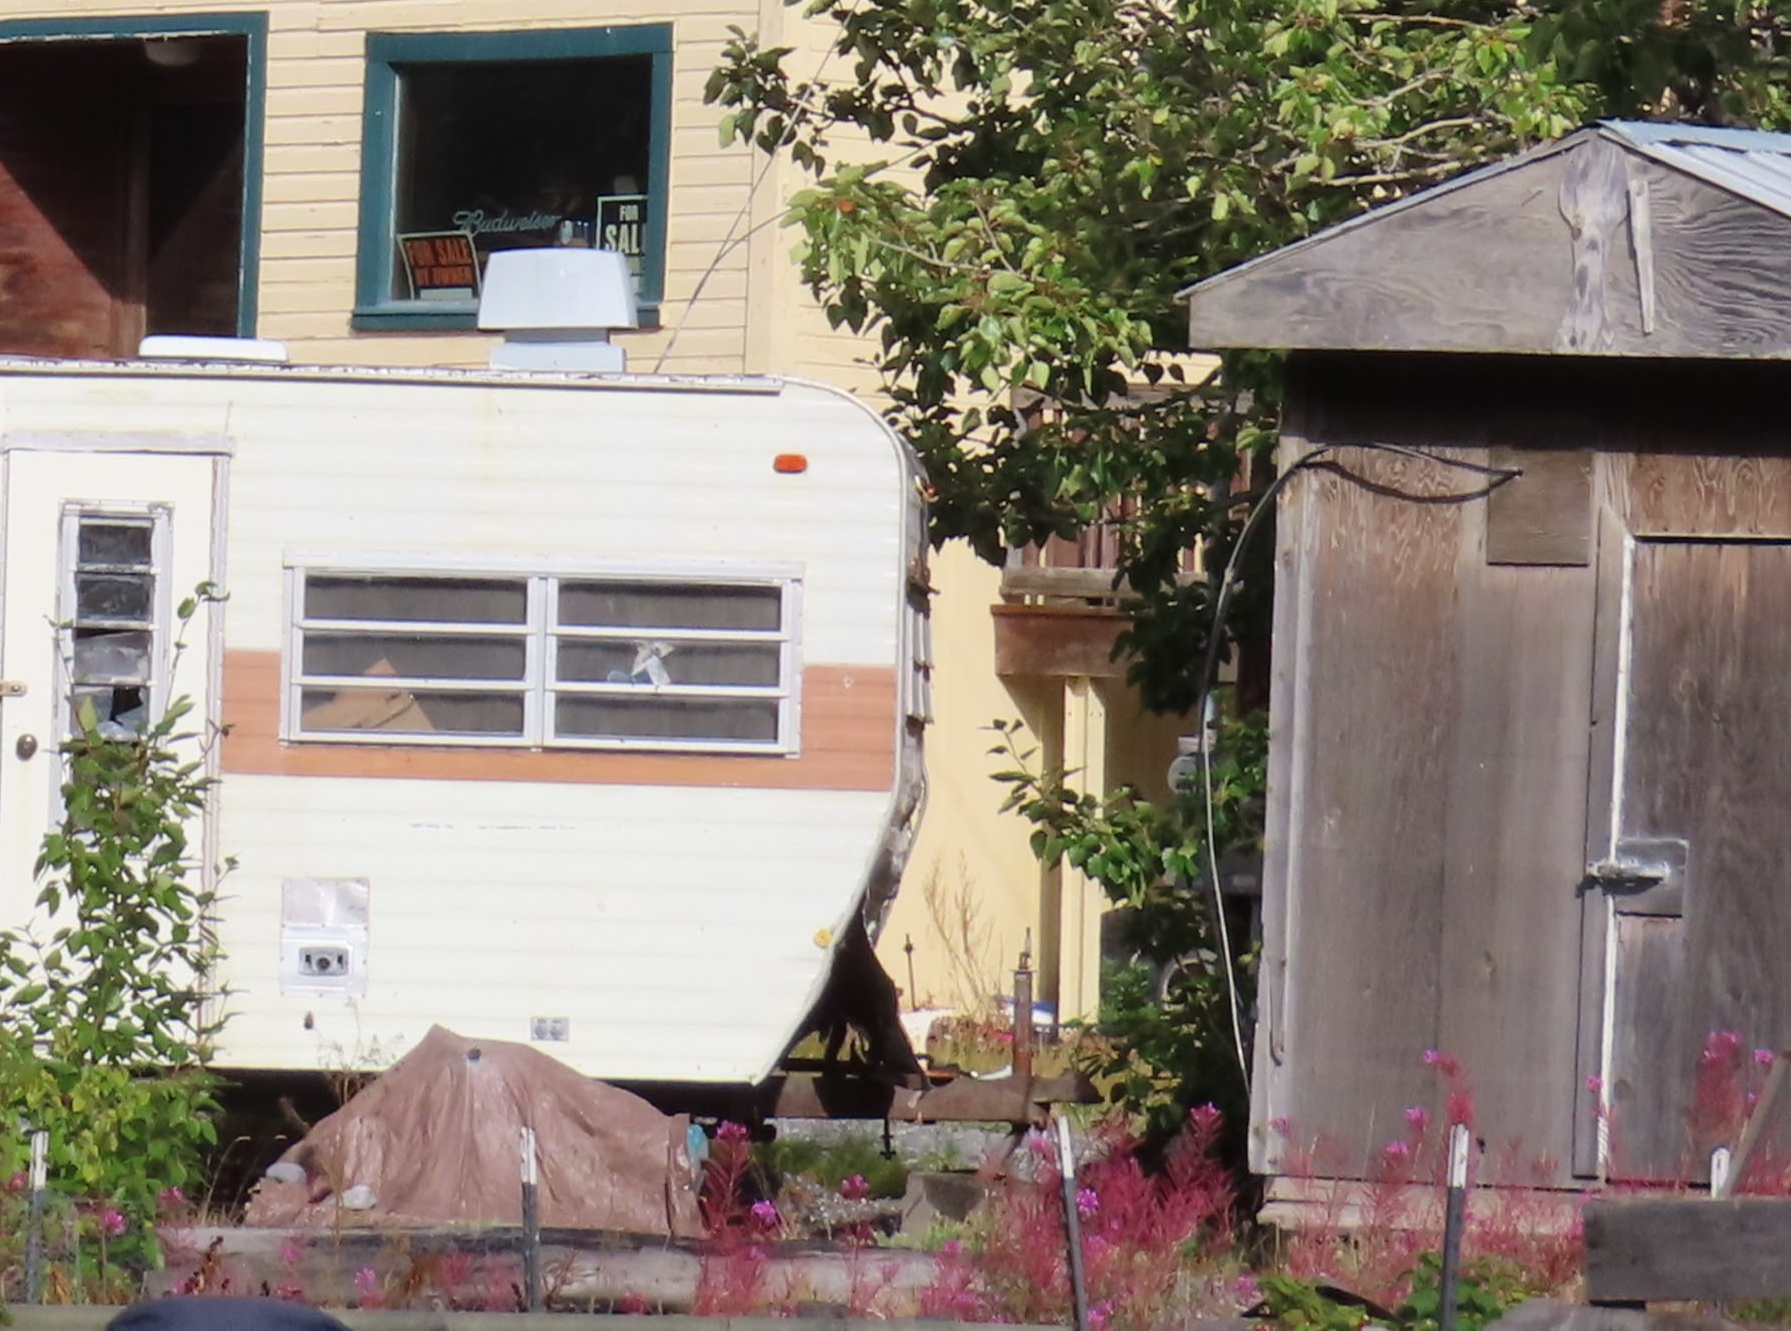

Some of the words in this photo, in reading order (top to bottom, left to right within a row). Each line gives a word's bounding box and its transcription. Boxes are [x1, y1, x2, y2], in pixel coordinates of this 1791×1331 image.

[453, 209, 561, 236] Budweiser
[620, 205, 639, 221] FOR
[435, 238, 472, 264] SALE
[605, 223, 646, 254] SAL
